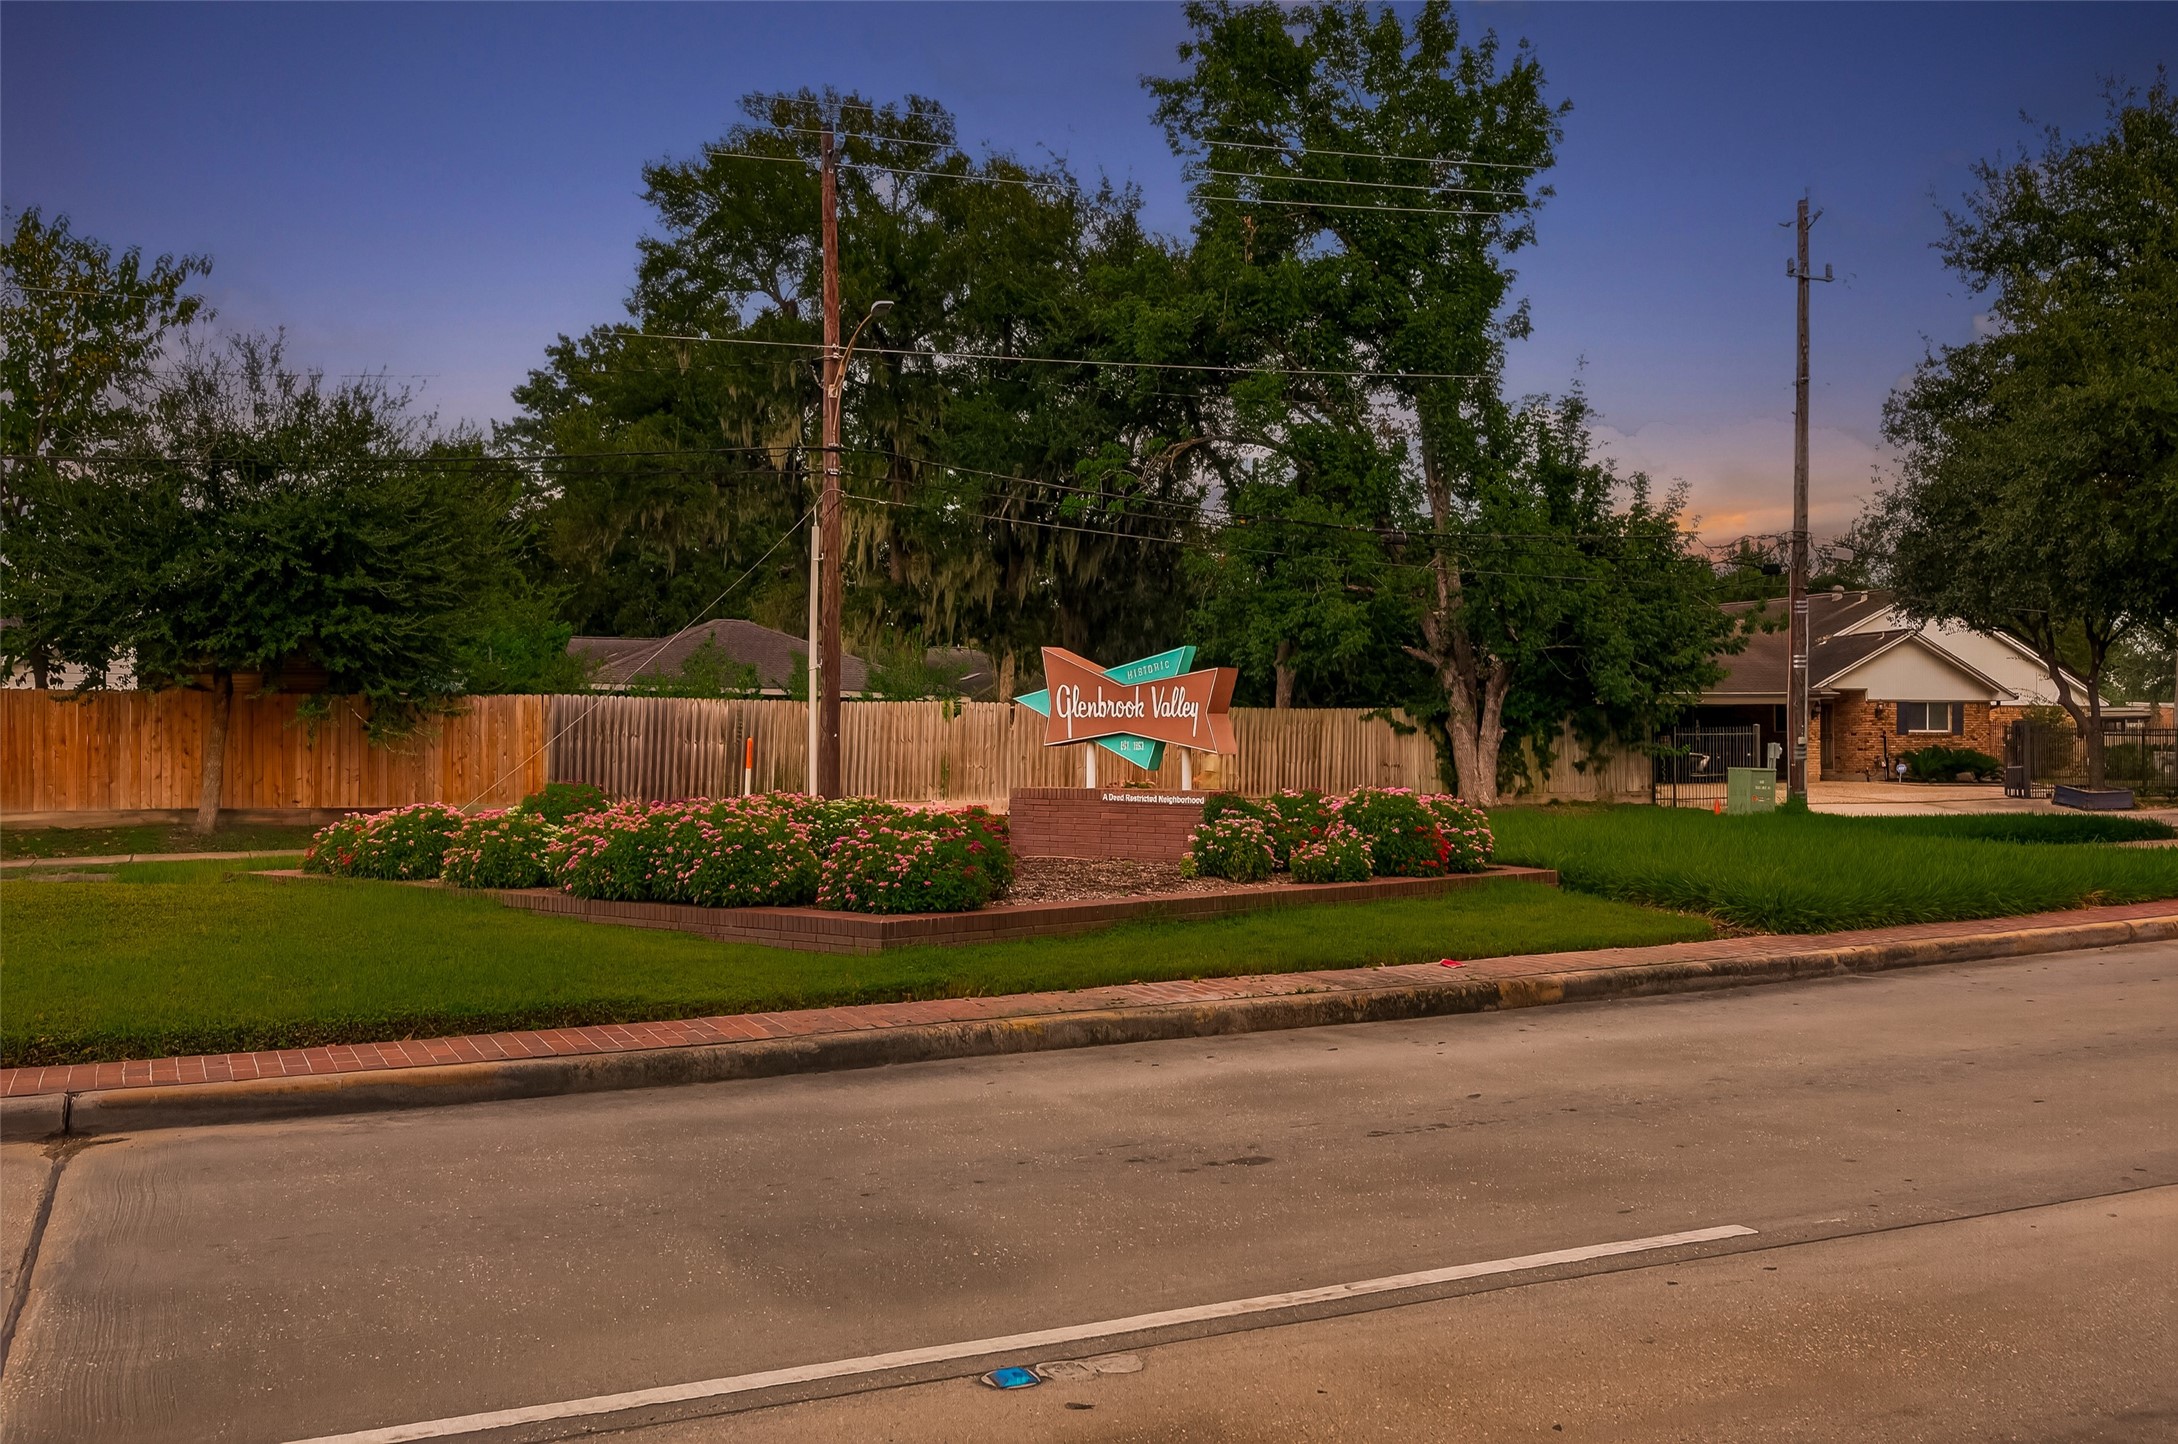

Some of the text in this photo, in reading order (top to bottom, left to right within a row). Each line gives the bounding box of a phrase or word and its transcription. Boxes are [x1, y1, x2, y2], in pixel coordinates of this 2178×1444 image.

[1127, 660, 1170, 680] HISTORIC
[1056, 684, 1199, 739] Glenbrook Valley
[1102, 793, 1205, 805] A Deed Restricted Neighborhood
